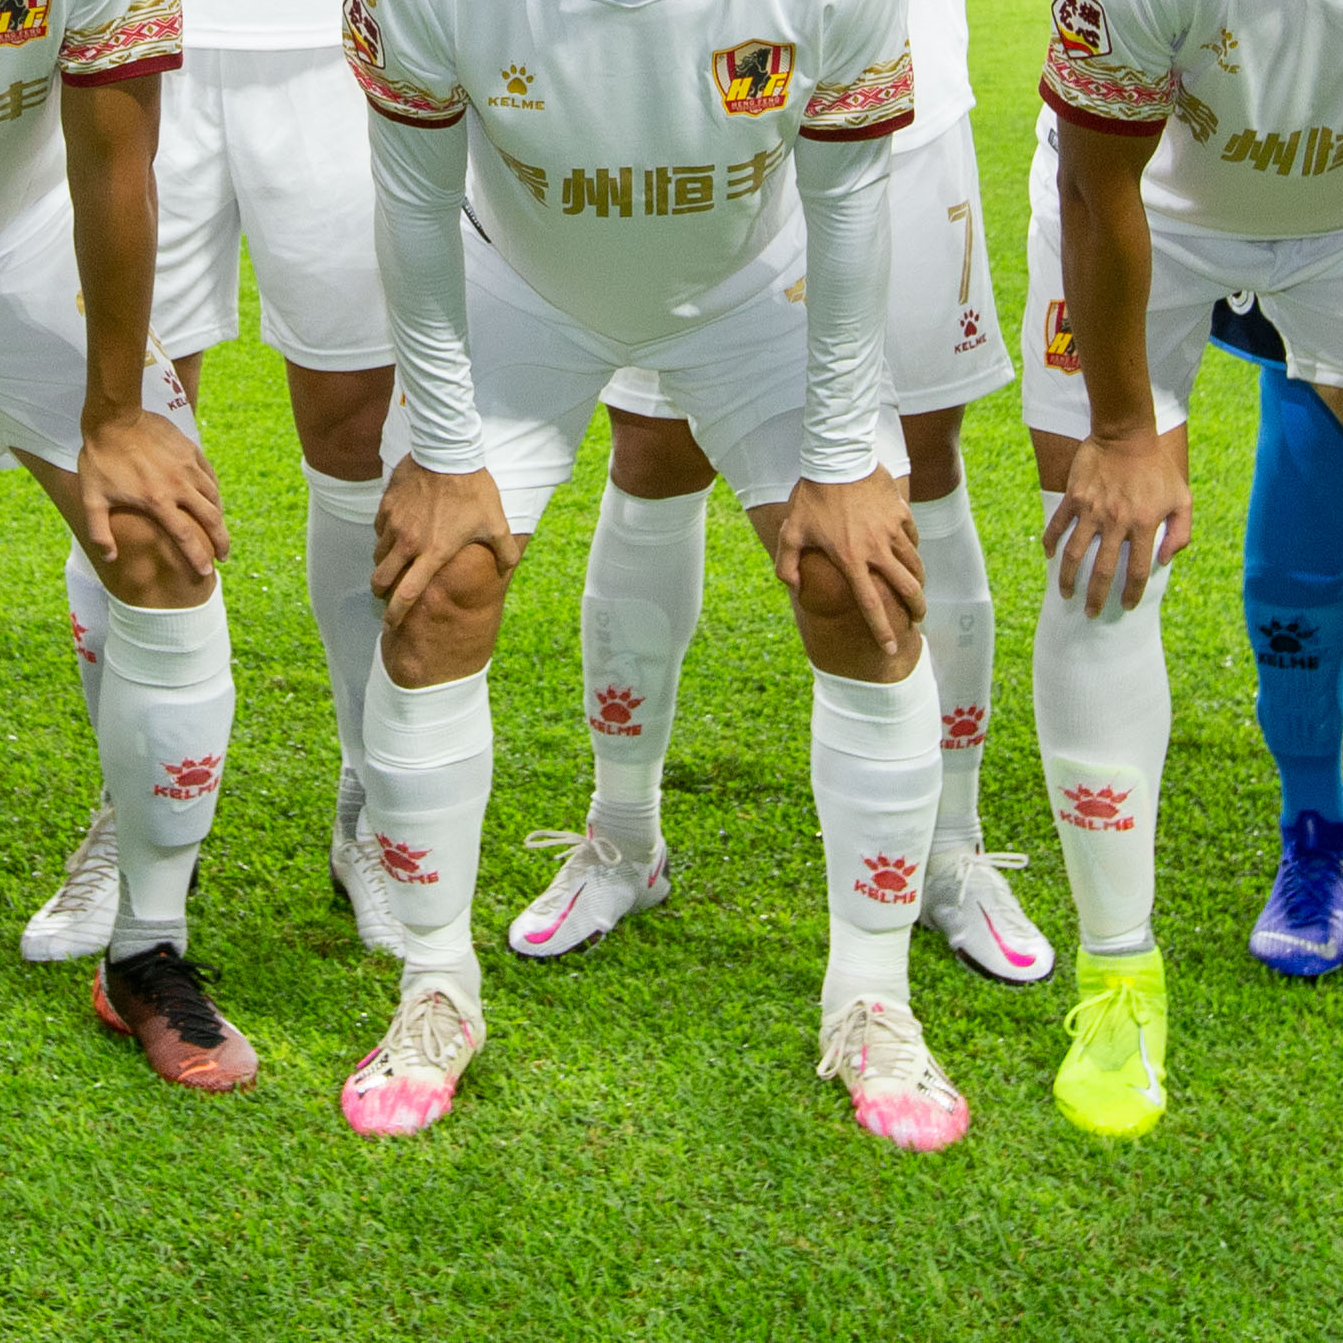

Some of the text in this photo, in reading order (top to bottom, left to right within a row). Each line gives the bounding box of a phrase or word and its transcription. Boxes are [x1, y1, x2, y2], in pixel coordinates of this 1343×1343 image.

[488, 97, 545, 110] KELME
[947, 201, 973, 306] 7
[954, 333, 987, 354] KELME
[167, 396, 187, 411] KEL
[589, 718, 642, 736] KELME
[1060, 810, 1134, 831] KELME
[854, 879, 917, 904] KELME
